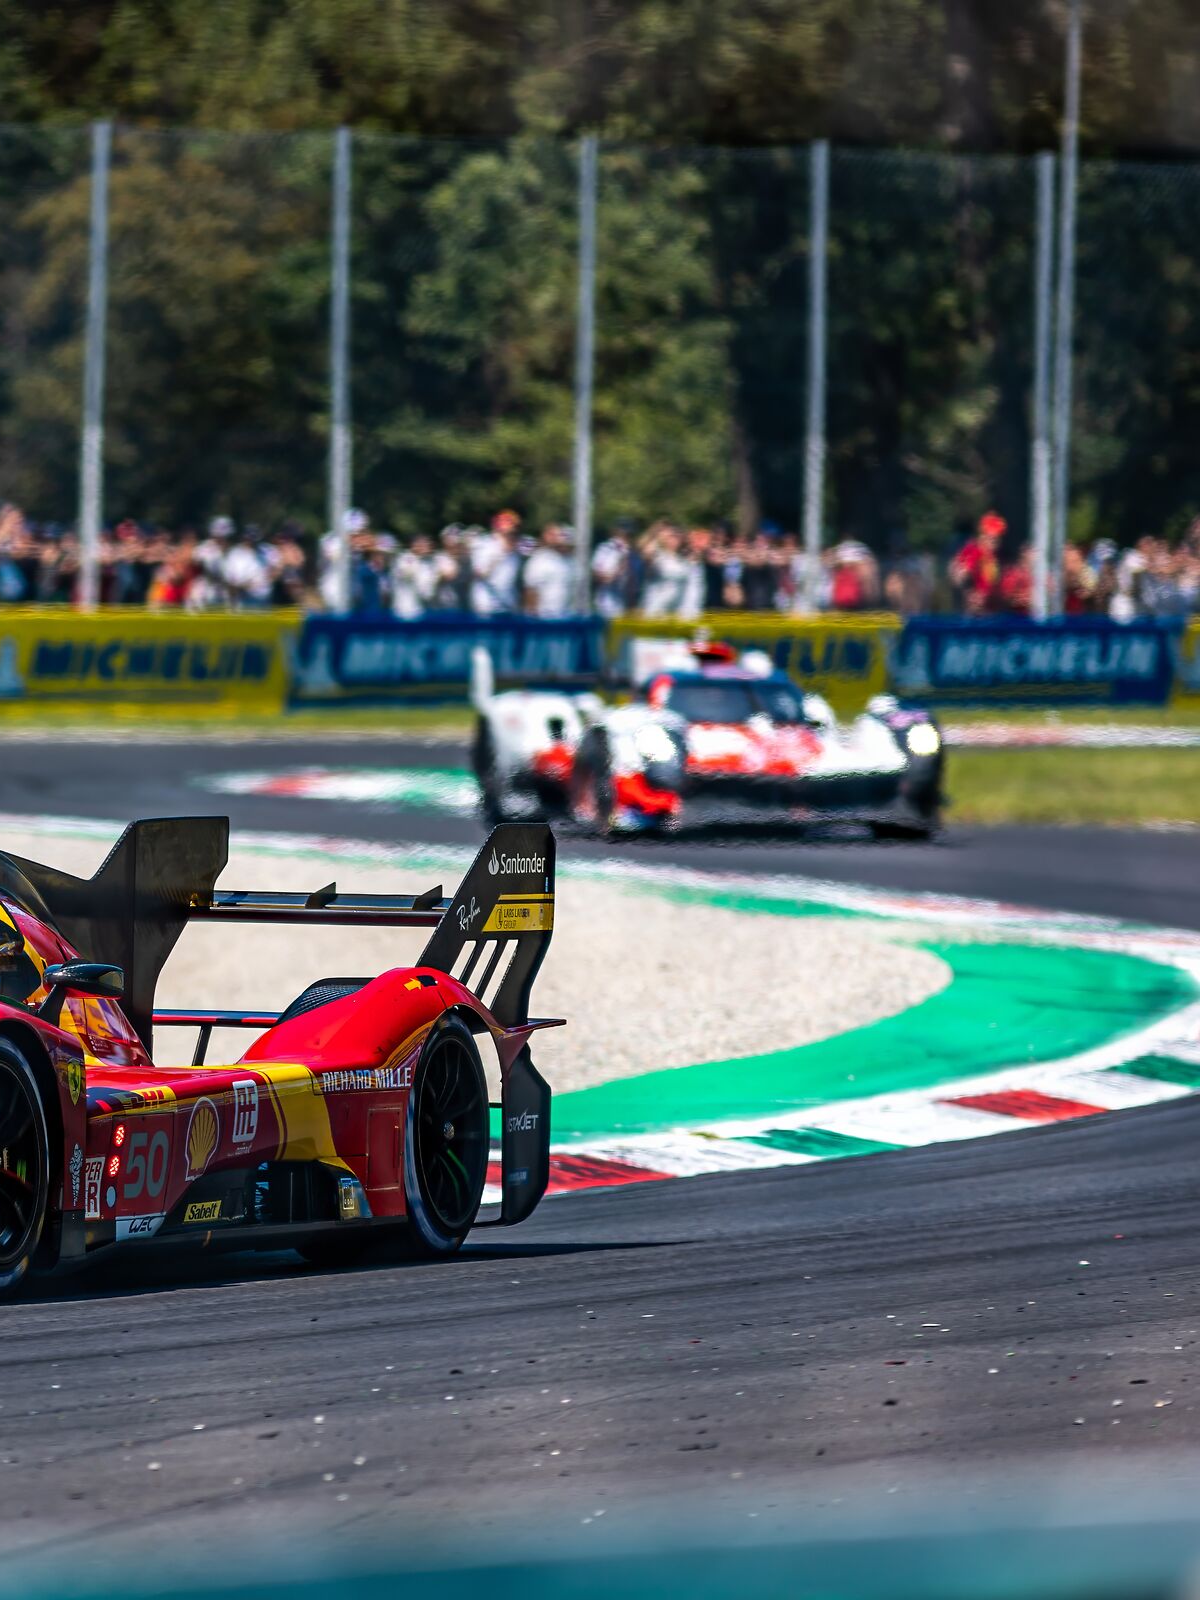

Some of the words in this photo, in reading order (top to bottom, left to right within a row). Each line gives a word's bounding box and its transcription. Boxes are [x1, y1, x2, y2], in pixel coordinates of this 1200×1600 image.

[30, 639, 275, 682] MICHELIN
[938, 635, 1161, 678] MICHELIN
[500, 852, 546, 874] Santander
[322, 1069, 371, 1092] RICHARD
[373, 1067, 411, 1088] MILLE
[124, 1131, 169, 1199] 50
[188, 1202, 218, 1220] Sabelt
[129, 1218, 152, 1234] WEC
